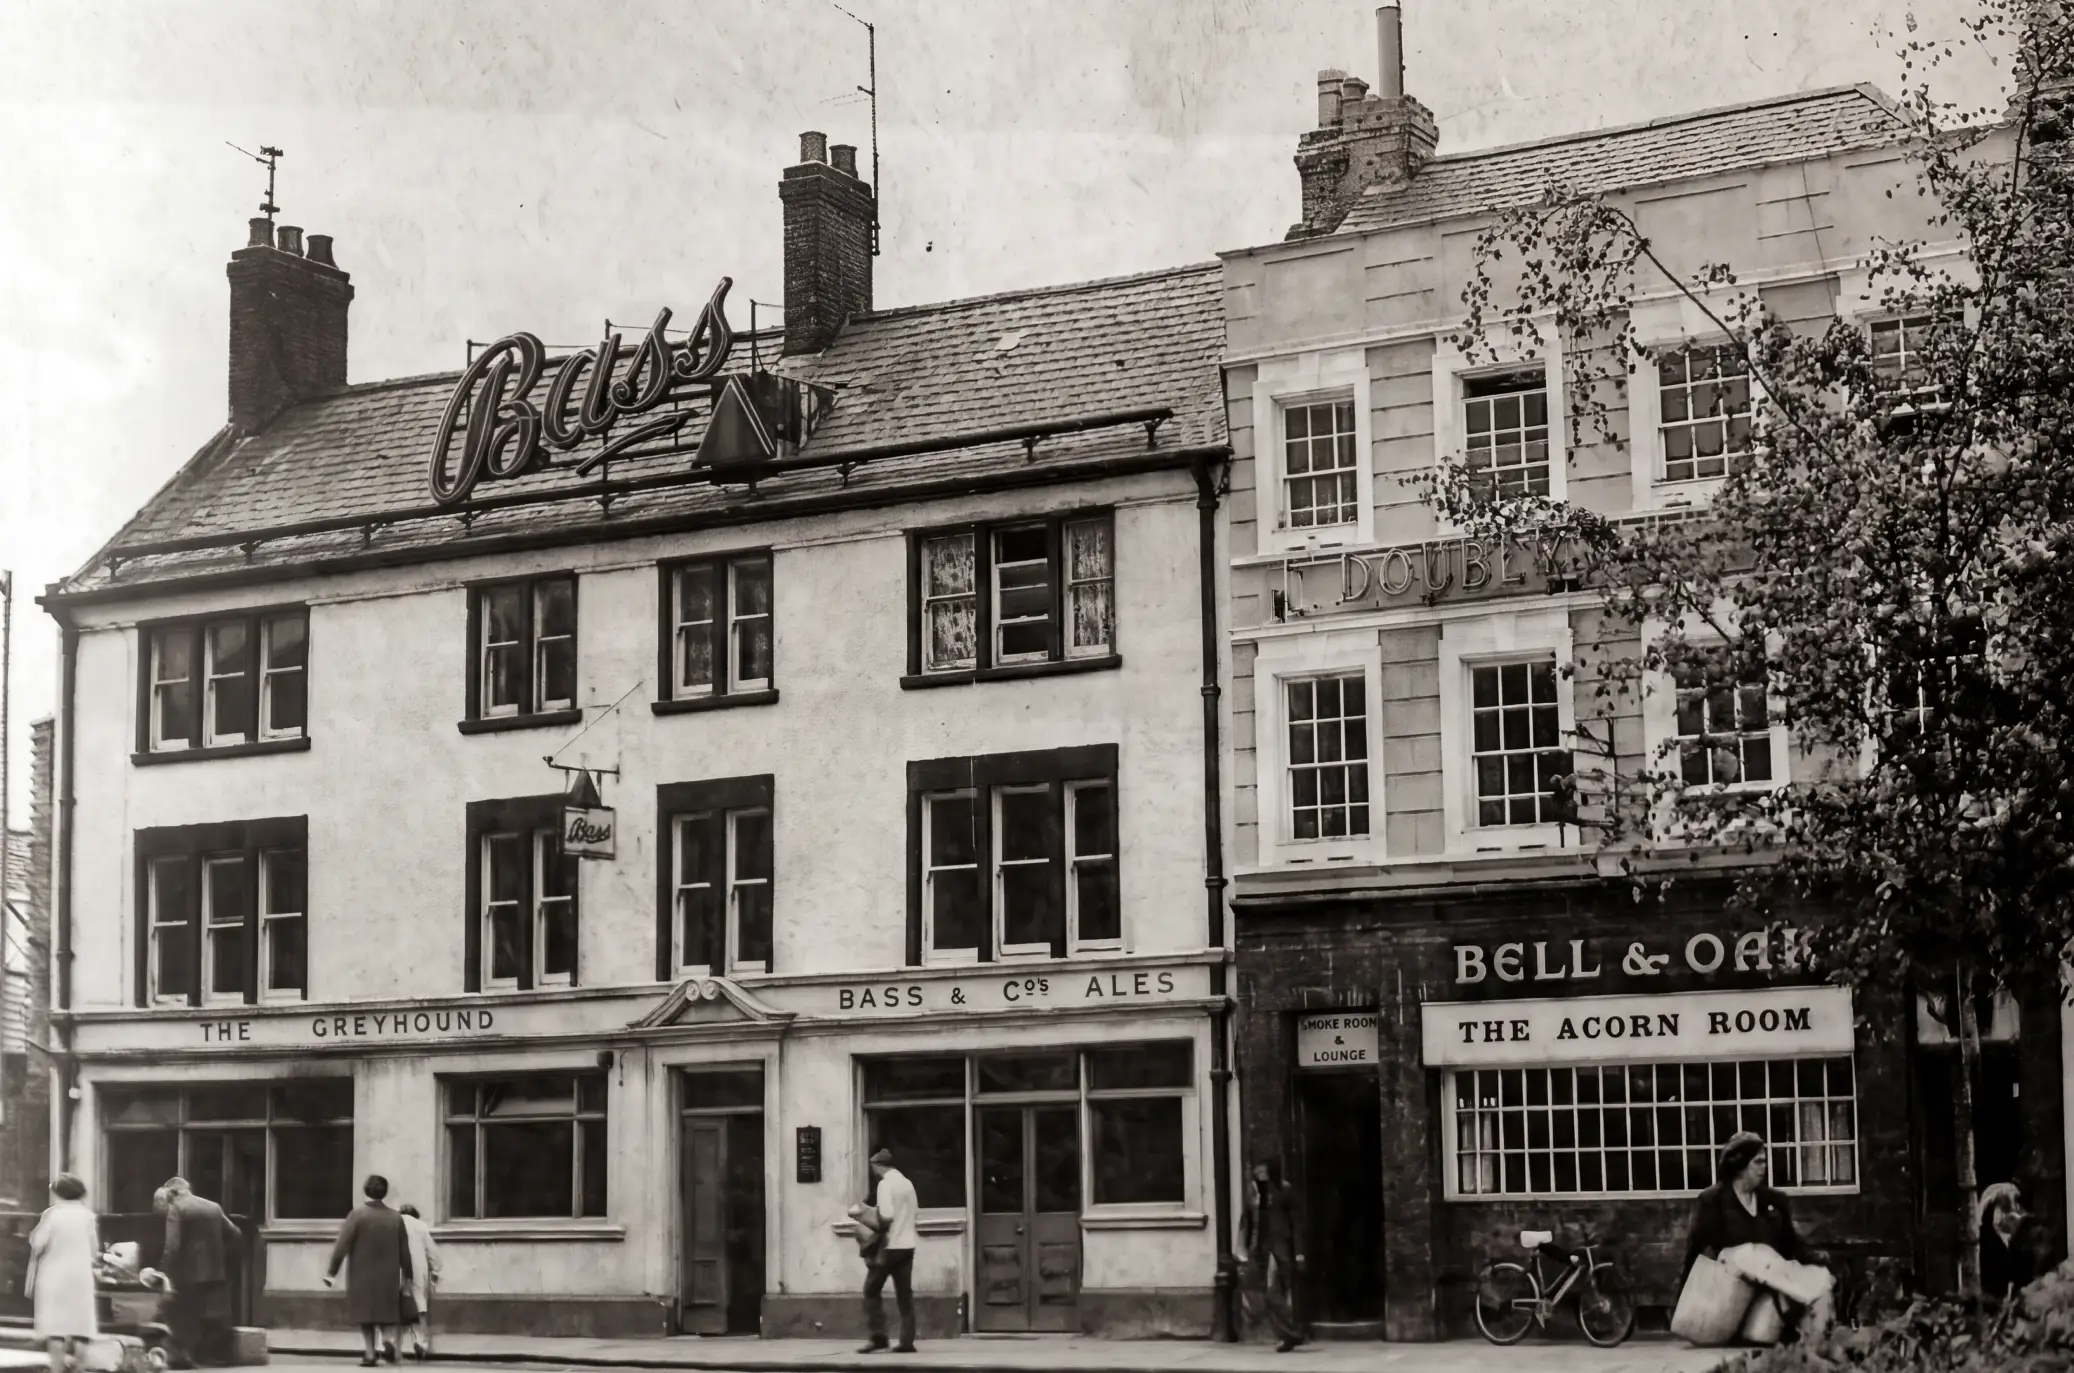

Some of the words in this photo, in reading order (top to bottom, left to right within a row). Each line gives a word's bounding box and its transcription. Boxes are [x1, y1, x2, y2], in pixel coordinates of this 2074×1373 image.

[428, 276, 734, 504] Bass
[1341, 533, 1577, 602] DOUBL
[566, 816, 611, 844] Bass
[1453, 939, 1601, 984] BELL
[1621, 942, 1670, 975] &
[838, 986, 924, 1010] BASS
[950, 987, 967, 1005] &
[1084, 972, 1175, 998] ALES
[200, 1022, 251, 1042] THE
[312, 1010, 494, 1037] GREYHOUND
[1301, 1018, 1339, 1030] SMOKE
[1344, 1016, 1378, 1029] ROOM
[1335, 1035, 1345, 1045] &
[1458, 1019, 1530, 1044] THE
[1557, 1014, 1680, 1041] ACORN
[1708, 1008, 1812, 1035] ROOM
[1314, 1049, 1366, 1062] LOUNGE
